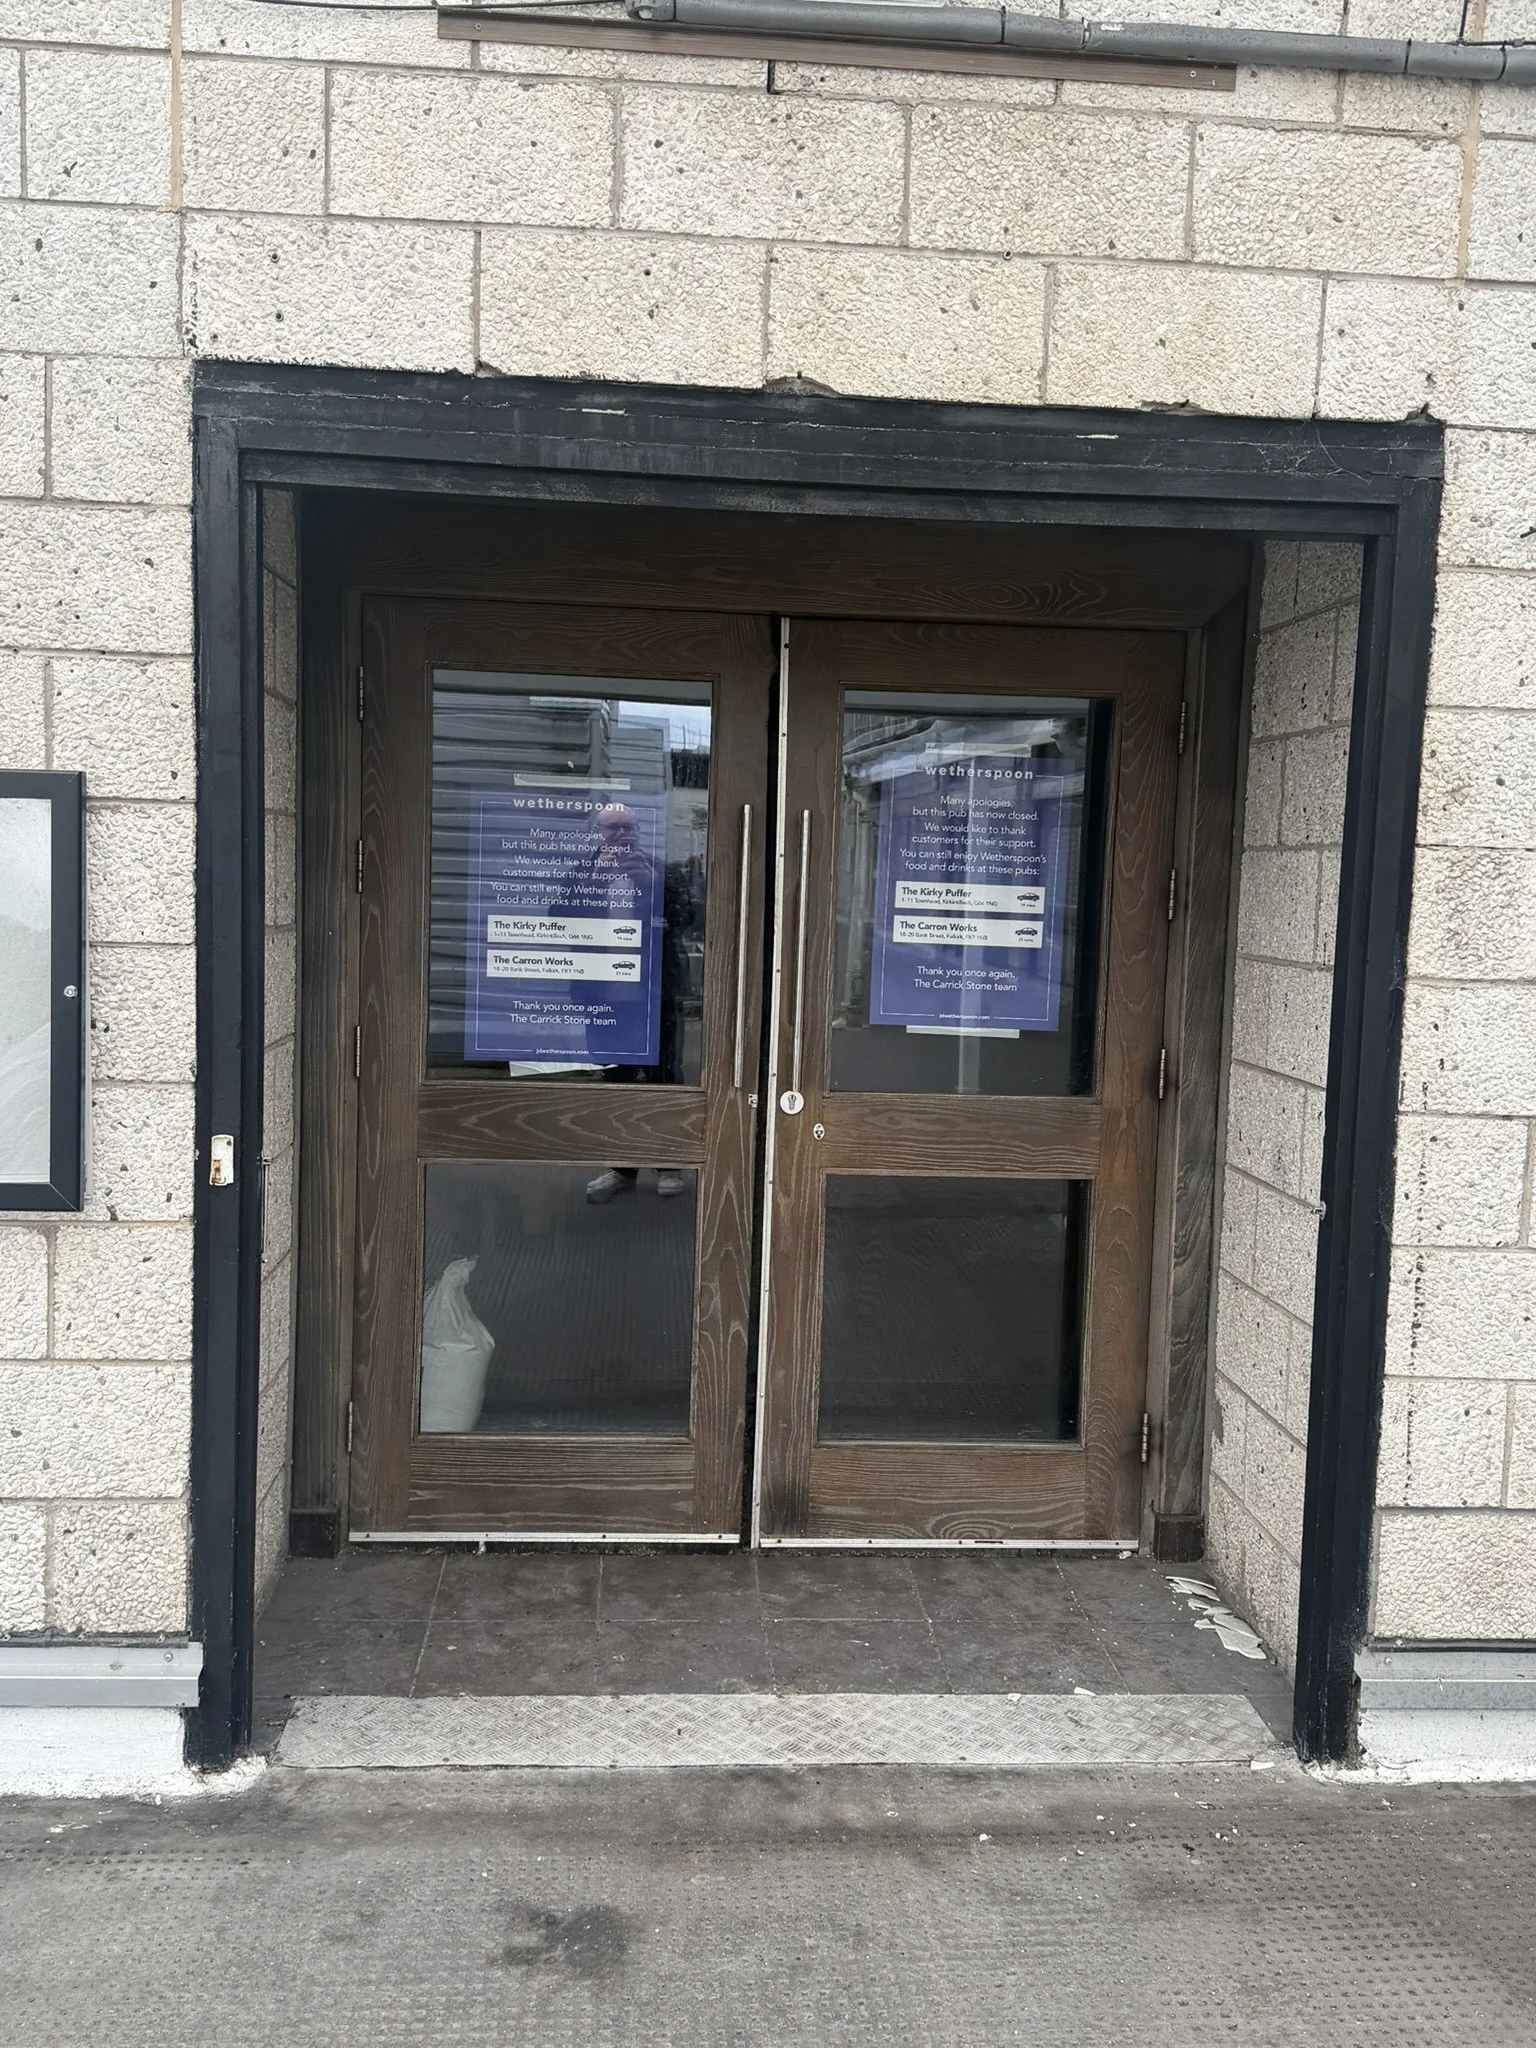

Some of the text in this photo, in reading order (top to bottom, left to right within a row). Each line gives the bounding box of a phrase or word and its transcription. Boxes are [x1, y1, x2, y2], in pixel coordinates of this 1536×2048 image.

[925, 766, 1034, 779] wetherspoon
[513, 798, 625, 812] wetherspoon
[940, 795, 1014, 809] Many apologies,
[912, 806, 1039, 821] but this pub has now closed.
[530, 828, 605, 841] Many apologies,
[924, 822, 1026, 835] We would like to thank
[502, 840, 632, 854] but this pub has now closed.
[911, 835, 1036, 849] customers for their support.
[514, 855, 620, 868] We would like to thank
[900, 848, 917, 858] You
[936, 850, 952, 860] still
[953, 852, 979, 863] enjoy
[980, 852, 1047, 864] Wetherspoon's
[905, 861, 1040, 876] food and drinks at these pubs:
[503, 869, 631, 882] customers for their support.
[490, 881, 642, 897] You can still enjoy Wetherspoon's
[901, 887, 972, 898] The Kirky Puffer
[496, 894, 635, 910] food and drinks at these pubs:
[494, 920, 567, 932] The Kirky Puffer
[900, 921, 977, 932] The Carron Works
[493, 955, 574, 966] The Carron Works
[916, 966, 1016, 980] Thank you once again.
[914, 979, 1018, 991] The Carrick Stone team
[512, 1000, 614, 1015] Thank you once again.
[510, 1013, 617, 1026] The Carrick Stone team
